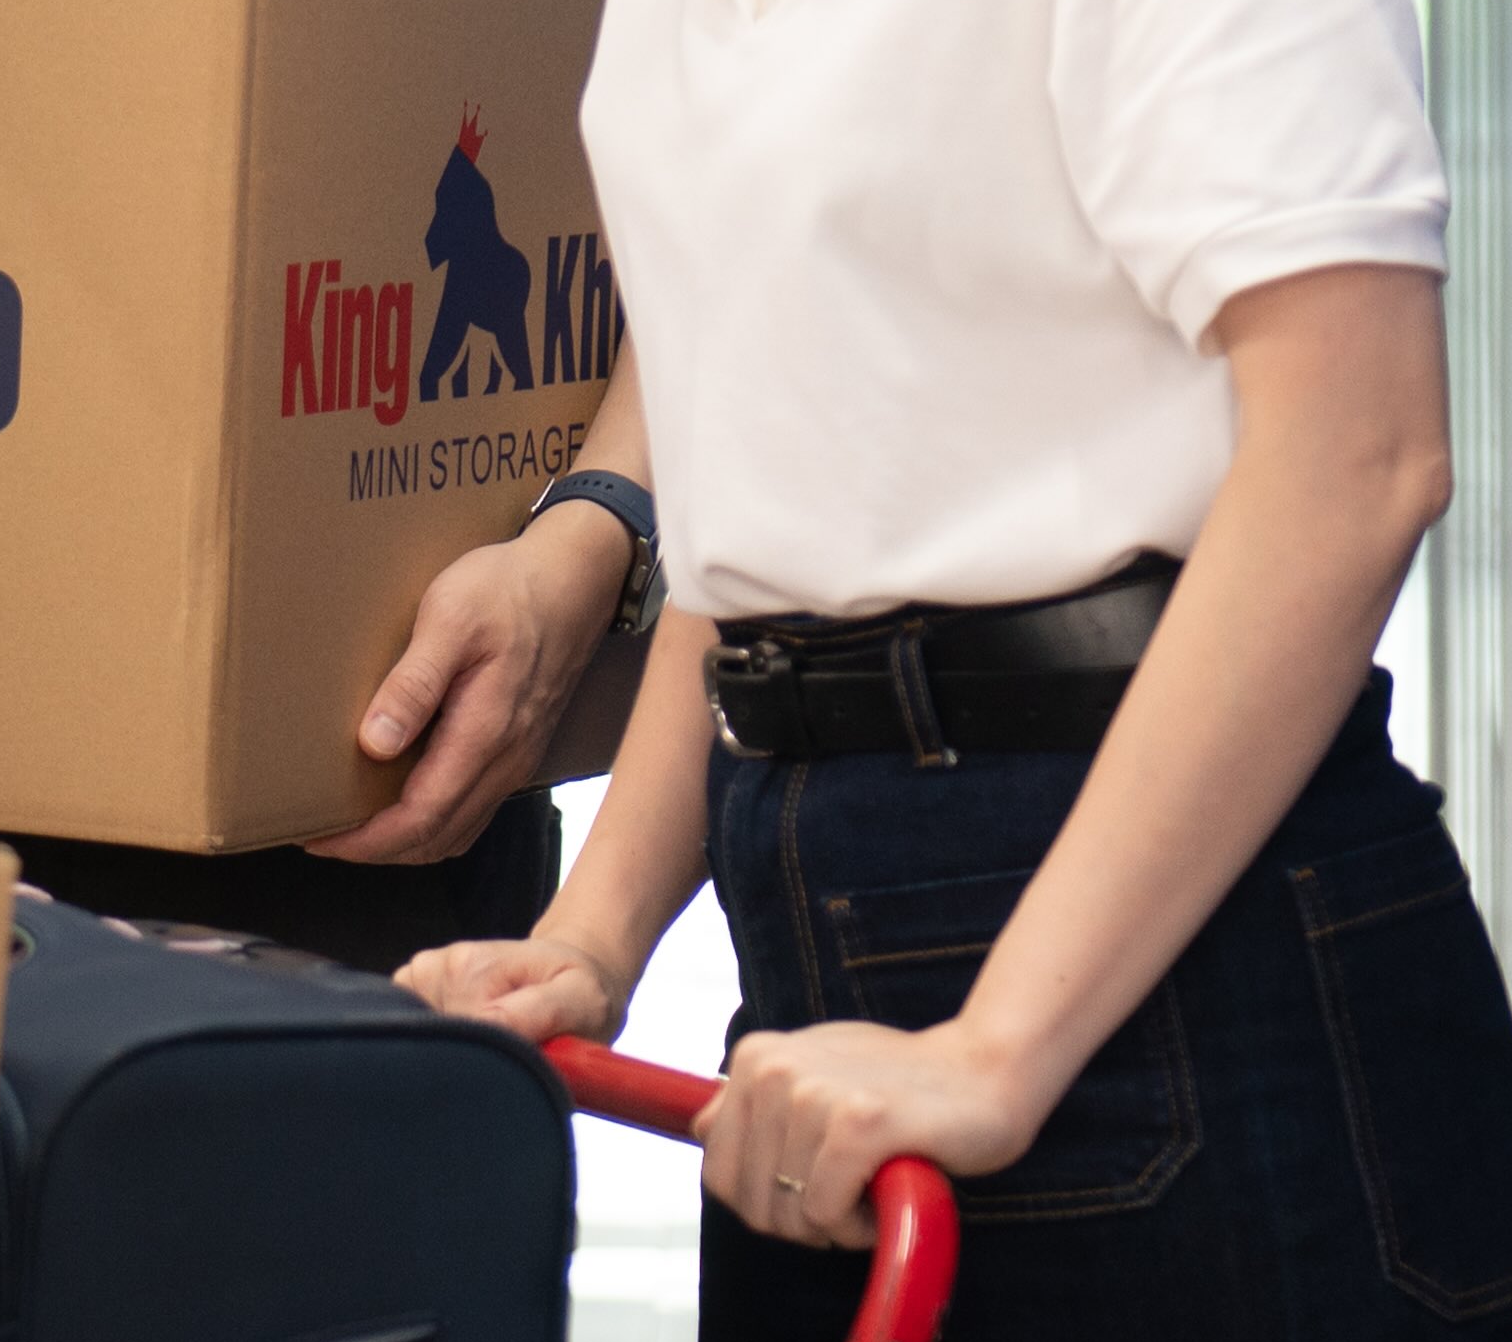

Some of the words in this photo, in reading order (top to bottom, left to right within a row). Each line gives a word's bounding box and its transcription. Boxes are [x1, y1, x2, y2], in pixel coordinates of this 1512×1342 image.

[281, 259, 414, 427] King
[542, 232, 626, 386] Kh
[348, 442, 420, 502] MINI
